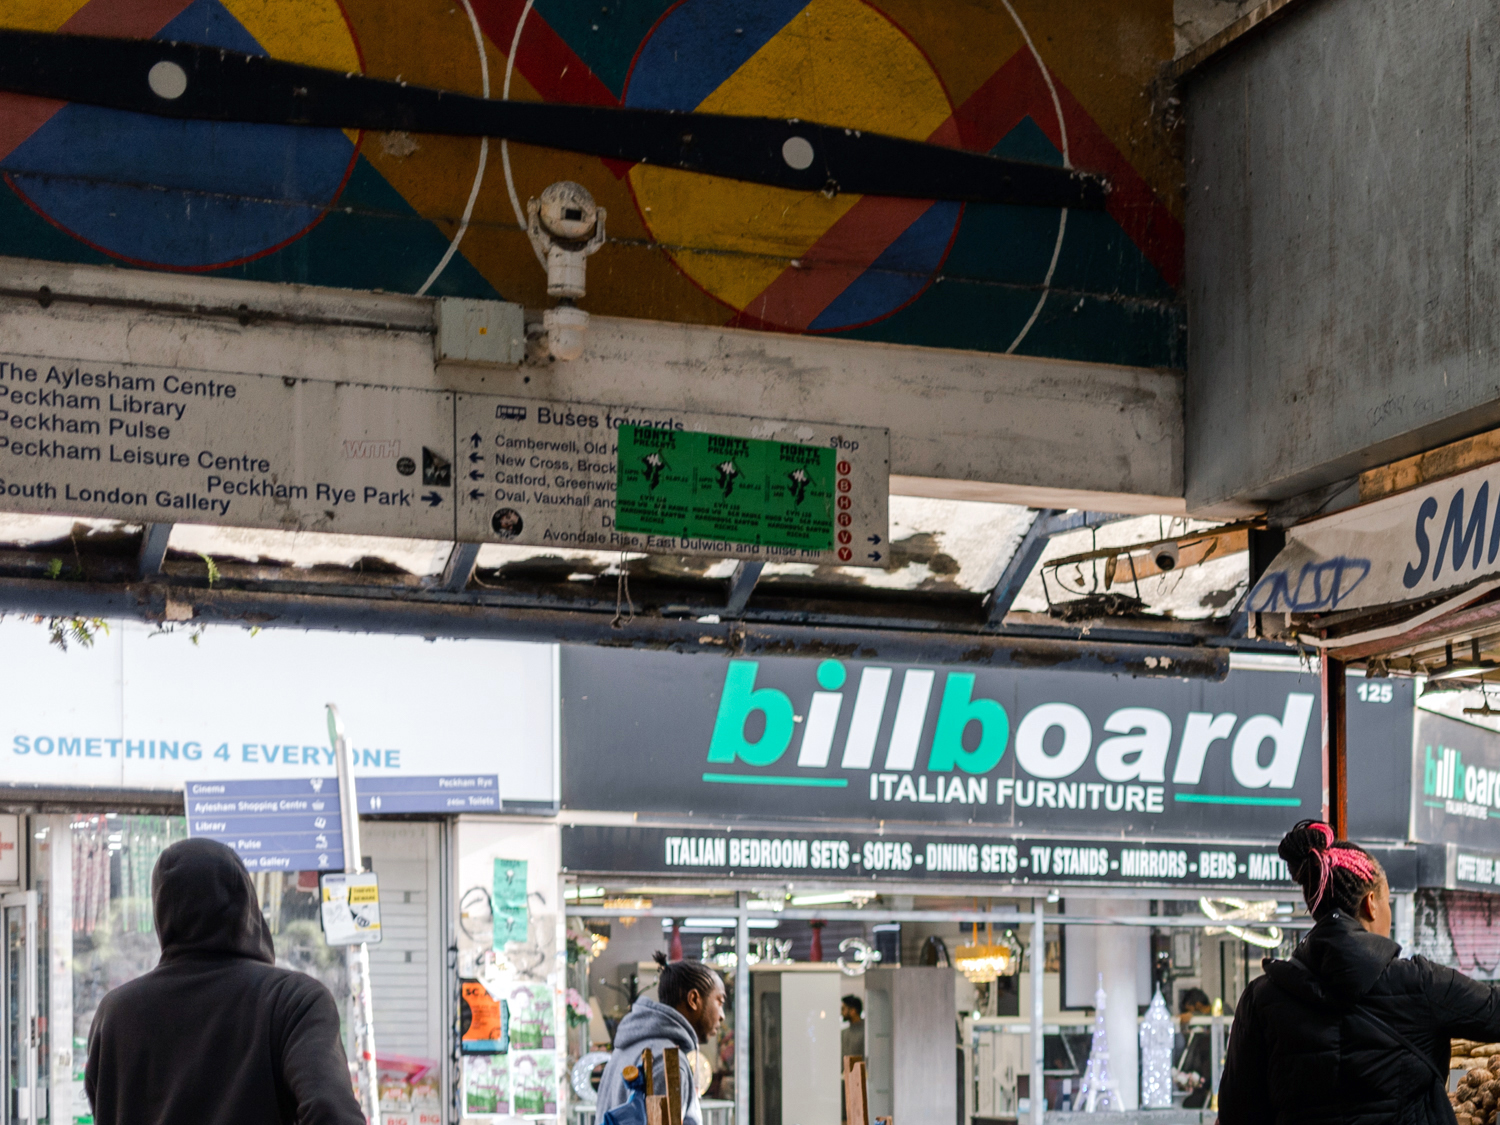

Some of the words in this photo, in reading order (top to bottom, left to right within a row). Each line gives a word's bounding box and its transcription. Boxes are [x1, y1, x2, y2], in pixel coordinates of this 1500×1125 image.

[0, 362, 38, 384] The
[45, 365, 156, 393] Aylesham
[163, 376, 238, 400] Centre
[0, 384, 101, 412] Peckham
[108, 391, 187, 420] Library
[0, 409, 101, 436] Peckham
[108, 418, 171, 440] Pulse
[537, 406, 600, 429] Buses
[495, 434, 580, 456] Camberwell,
[584, 442, 607, 455] Old
[634, 428, 676, 442] MONTE
[708, 435, 750, 450] MONTE
[829, 435, 860, 452] Stop
[0, 435, 101, 463] Peckham
[109, 443, 191, 467] Leisure
[198, 450, 271, 474] Centre
[779, 444, 821, 458] MONTE
[495, 453, 526, 467] New
[530, 456, 574, 472] Cross,
[577, 460, 617, 474] Brock
[206, 475, 308, 500] Peckham
[315, 483, 357, 506] Rye
[364, 486, 412, 508] Park
[495, 471, 550, 491] Catford,
[554, 474, 618, 493] Greenwic
[0, 477, 57, 501] South
[65, 483, 148, 507] London
[155, 489, 232, 517] Gallery
[495, 488, 531, 508] Oval,
[534, 491, 592, 509] Vauxhall
[543, 528, 610, 547] Avondale
[611, 533, 645, 549] Rise,
[647, 534, 678, 549] East
[680, 536, 732, 555] Dulwich
[735, 540, 760, 556] and
[1356, 683, 1394, 703] 125
[706, 658, 1315, 790] billboard
[12, 734, 203, 761] SOMETHING
[213, 742, 232, 761] 4
[192, 784, 226, 795] Cinema
[438, 777, 475, 788] Peckham
[477, 777, 494, 789] Rye
[869, 773, 988, 805] ITALIAN
[996, 779, 1165, 814] FURNITURE
[194, 801, 236, 813] Aylesham
[238, 801, 278, 813] Shopping
[278, 799, 308, 810] Centre
[468, 796, 495, 807] Toilets
[195, 819, 227, 833] Library
[238, 839, 262, 850] Pulse
[256, 856, 291, 868] Gallery
[665, 836, 727, 867] ITALIAN
[729, 838, 808, 869] BEDROOM
[810, 840, 850, 869] SETS
[863, 843, 912, 871] SOFAS
[926, 844, 978, 873] DINING
[980, 845, 1018, 874] SETS
[1031, 846, 1051, 874] TV
[1053, 847, 1109, 876] STANDS
[1121, 849, 1187, 879] MIRRORS
[1200, 851, 1237, 879] BEDS
[1248, 853, 1292, 881] MATT
